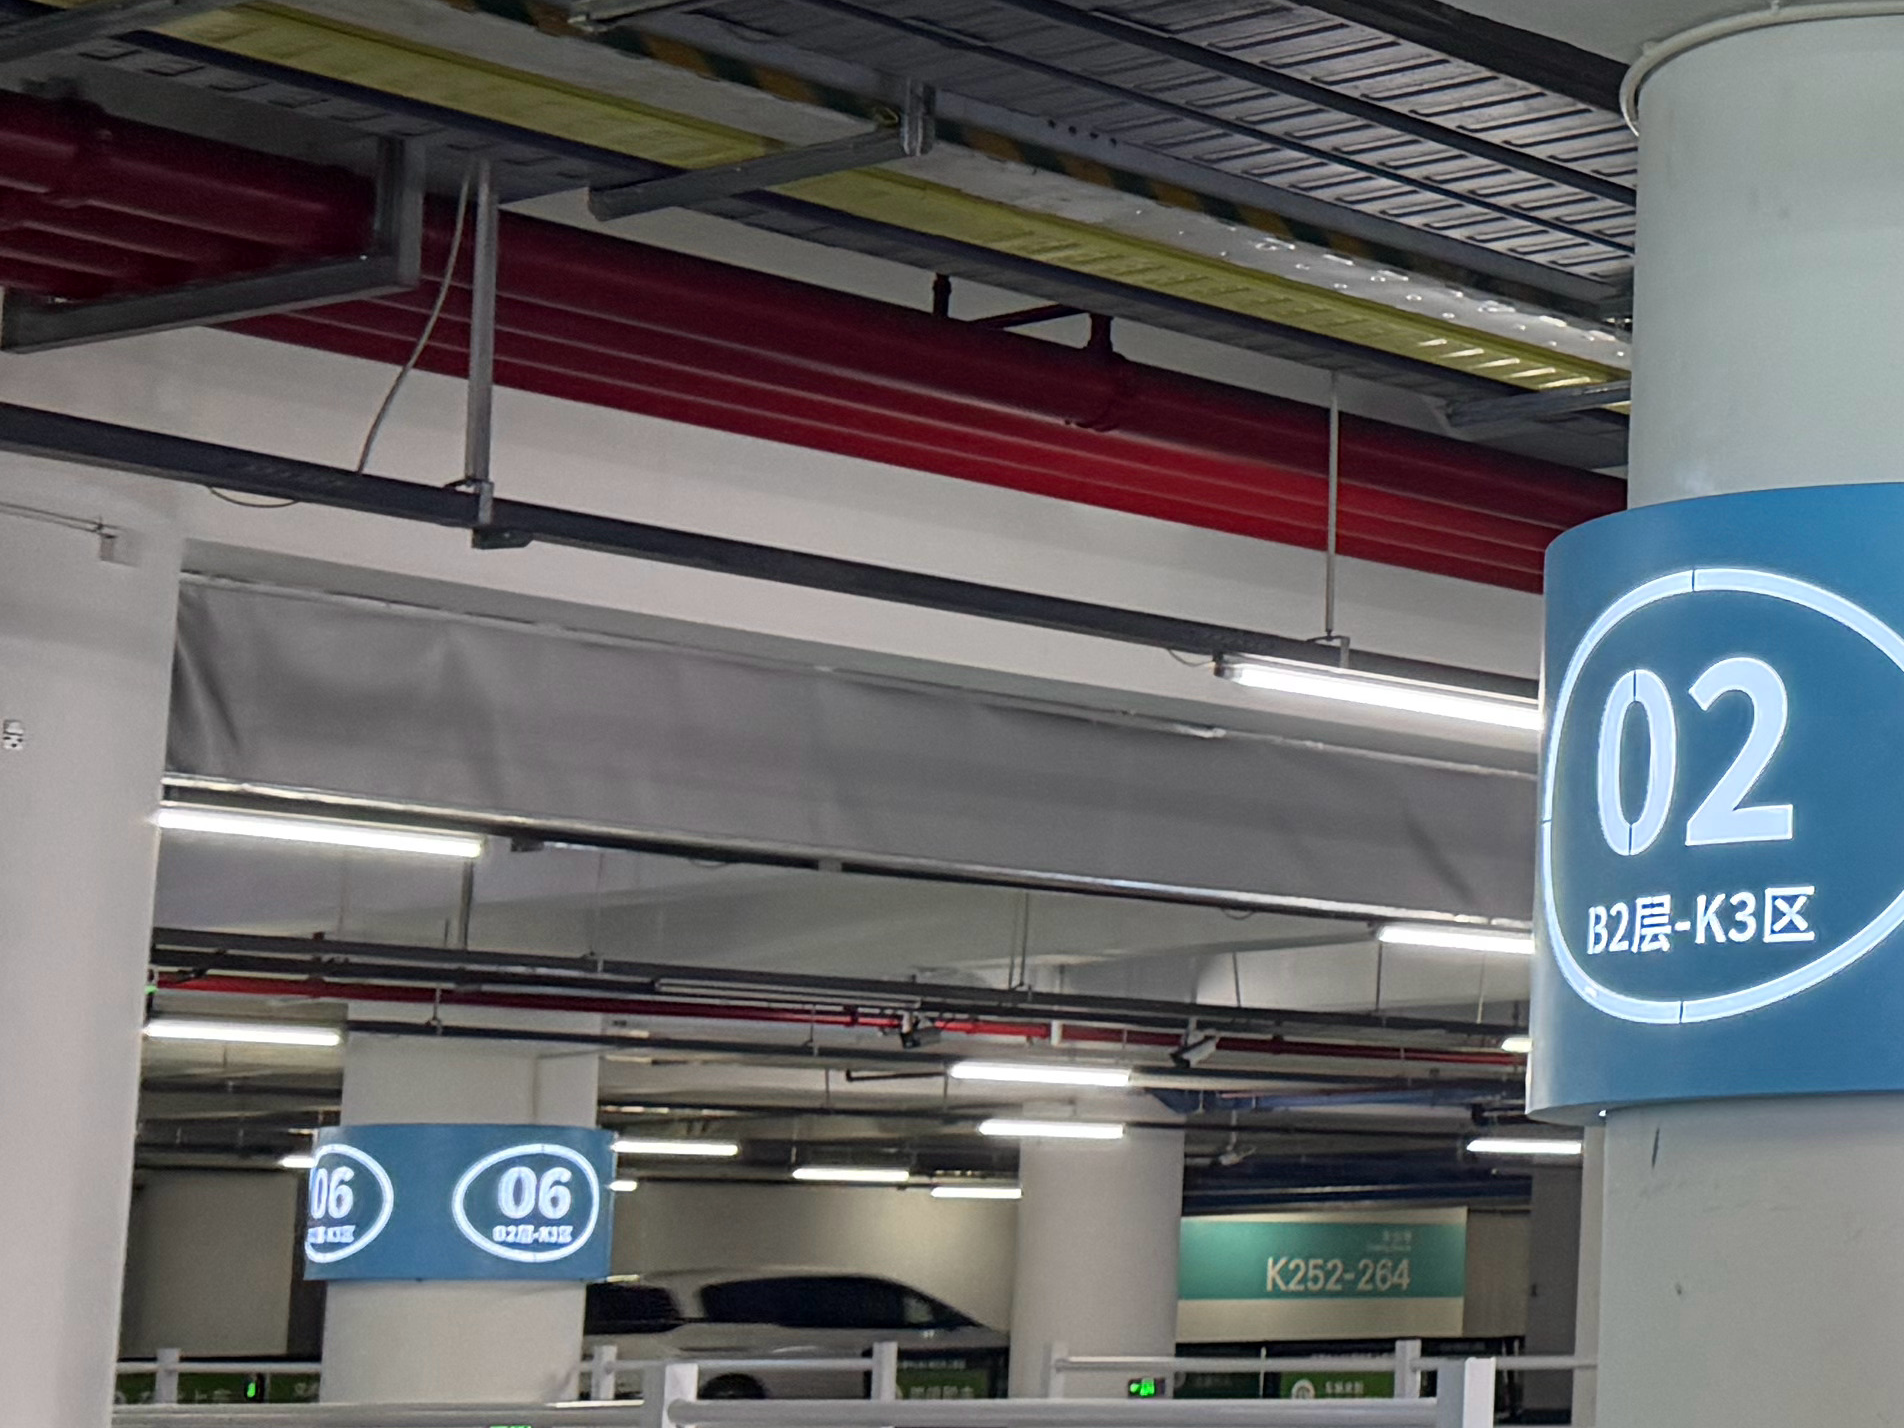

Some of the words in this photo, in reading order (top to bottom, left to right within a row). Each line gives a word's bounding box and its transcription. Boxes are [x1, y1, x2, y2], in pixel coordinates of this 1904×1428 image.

[1596, 656, 1794, 856] 02
[1586, 885, 1816, 956] B2层-K3区
[310, 1166, 356, 1220] 06
[498, 1166, 573, 1220] 06
[1265, 1255, 1411, 1293] K252-264
